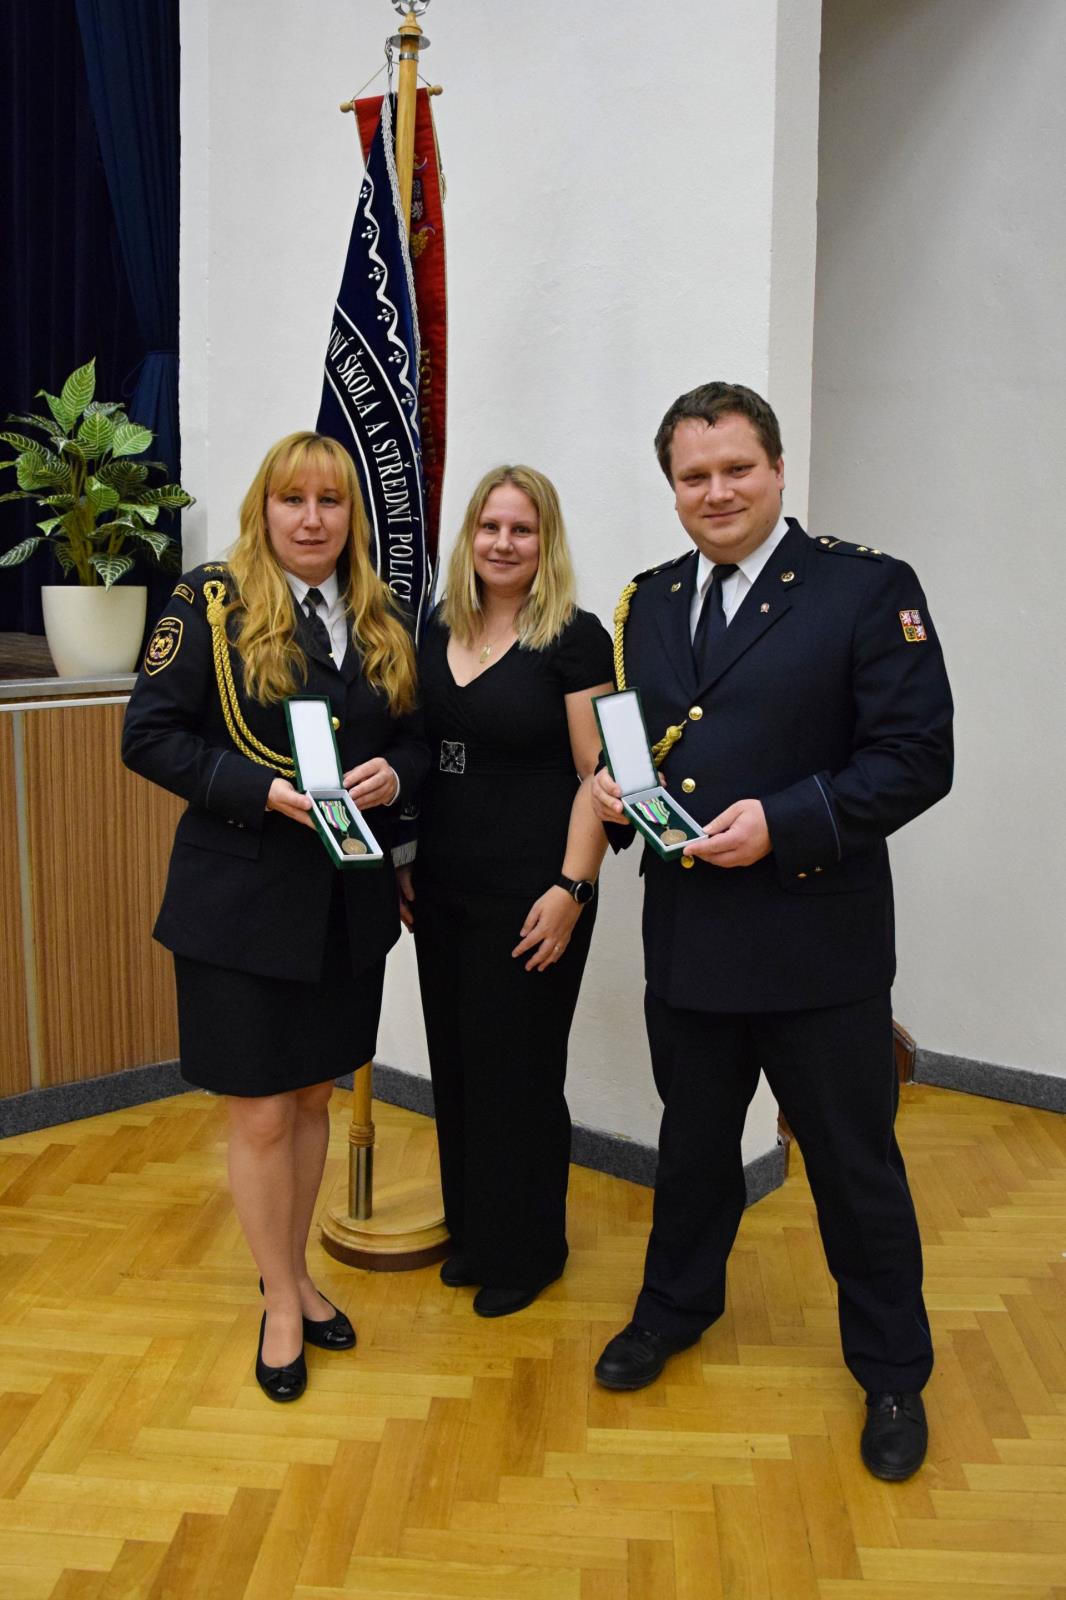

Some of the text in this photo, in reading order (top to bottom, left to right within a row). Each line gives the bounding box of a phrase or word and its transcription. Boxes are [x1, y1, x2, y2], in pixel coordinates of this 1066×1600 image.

[336, 348, 382, 418] ŠKOLA
[364, 421, 390, 438] A
[372, 438, 420, 525] STŘEDNÍ
